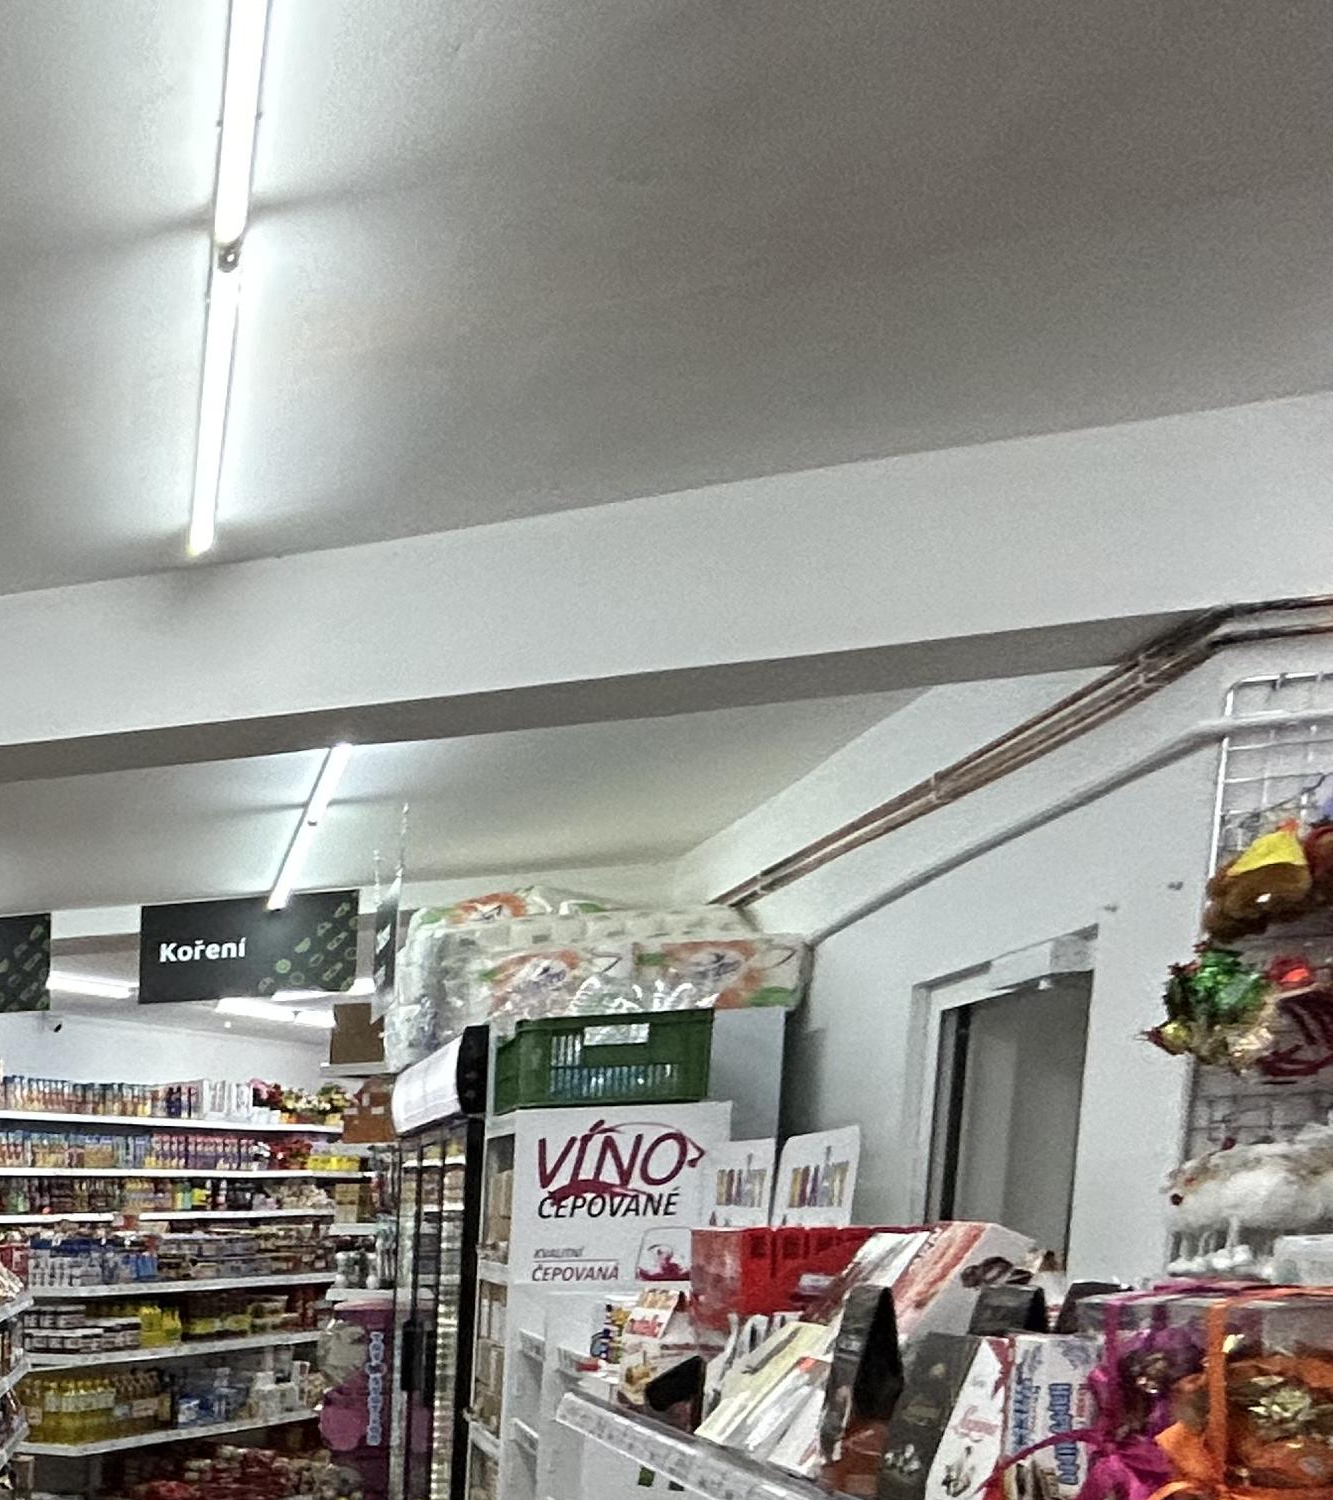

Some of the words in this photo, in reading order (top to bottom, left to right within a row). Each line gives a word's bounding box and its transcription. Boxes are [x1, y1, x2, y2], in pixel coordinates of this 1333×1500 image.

[158, 936, 247, 964] Koření
[538, 1119, 688, 1190] VÍNO
[533, 1261, 619, 1282] ČEPOVANÁ
